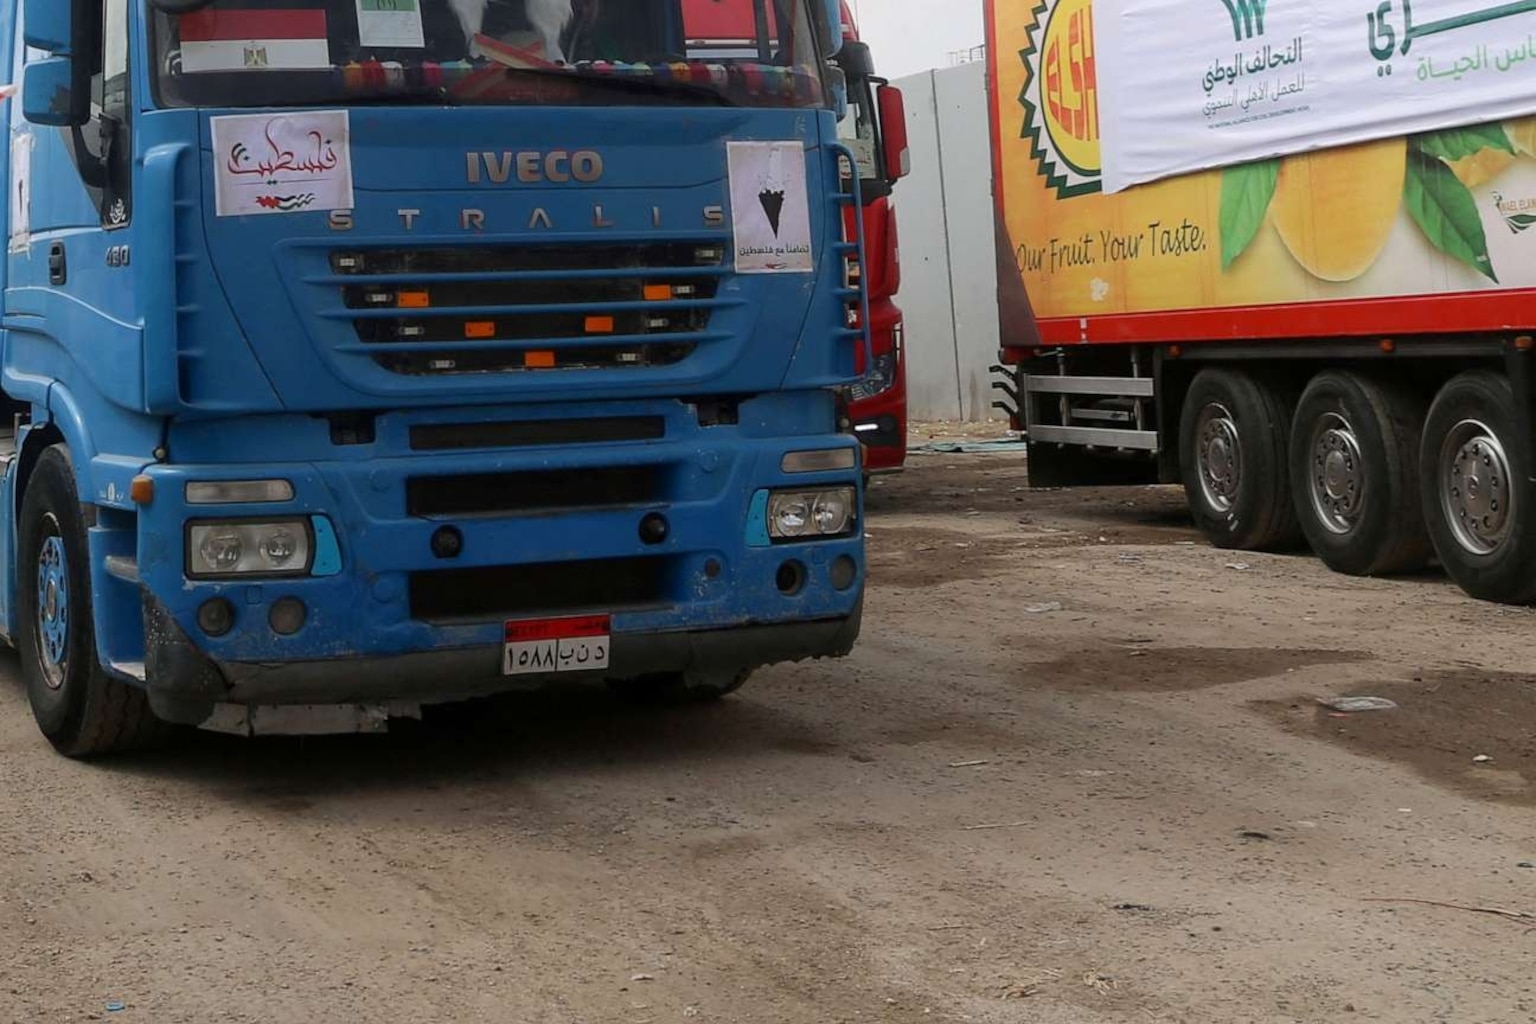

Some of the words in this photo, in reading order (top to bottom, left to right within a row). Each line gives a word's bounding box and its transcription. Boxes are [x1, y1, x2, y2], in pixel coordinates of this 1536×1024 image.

[1245, 36, 1303, 74] التحالف
[1417, 43, 1488, 81] الحياة
[1202, 52, 1243, 97] الوطني
[227, 115, 338, 186] فلسطين
[466, 149, 604, 184] IVECO
[328, 204, 726, 232] STRALIS
[1016, 242, 1047, 274] Our
[1049, 233, 1096, 274] Fruit.
[1100, 229, 1144, 264] Your
[1148, 218, 1207, 257] Taste.
[508, 644, 554, 670] ١٥٨٨
